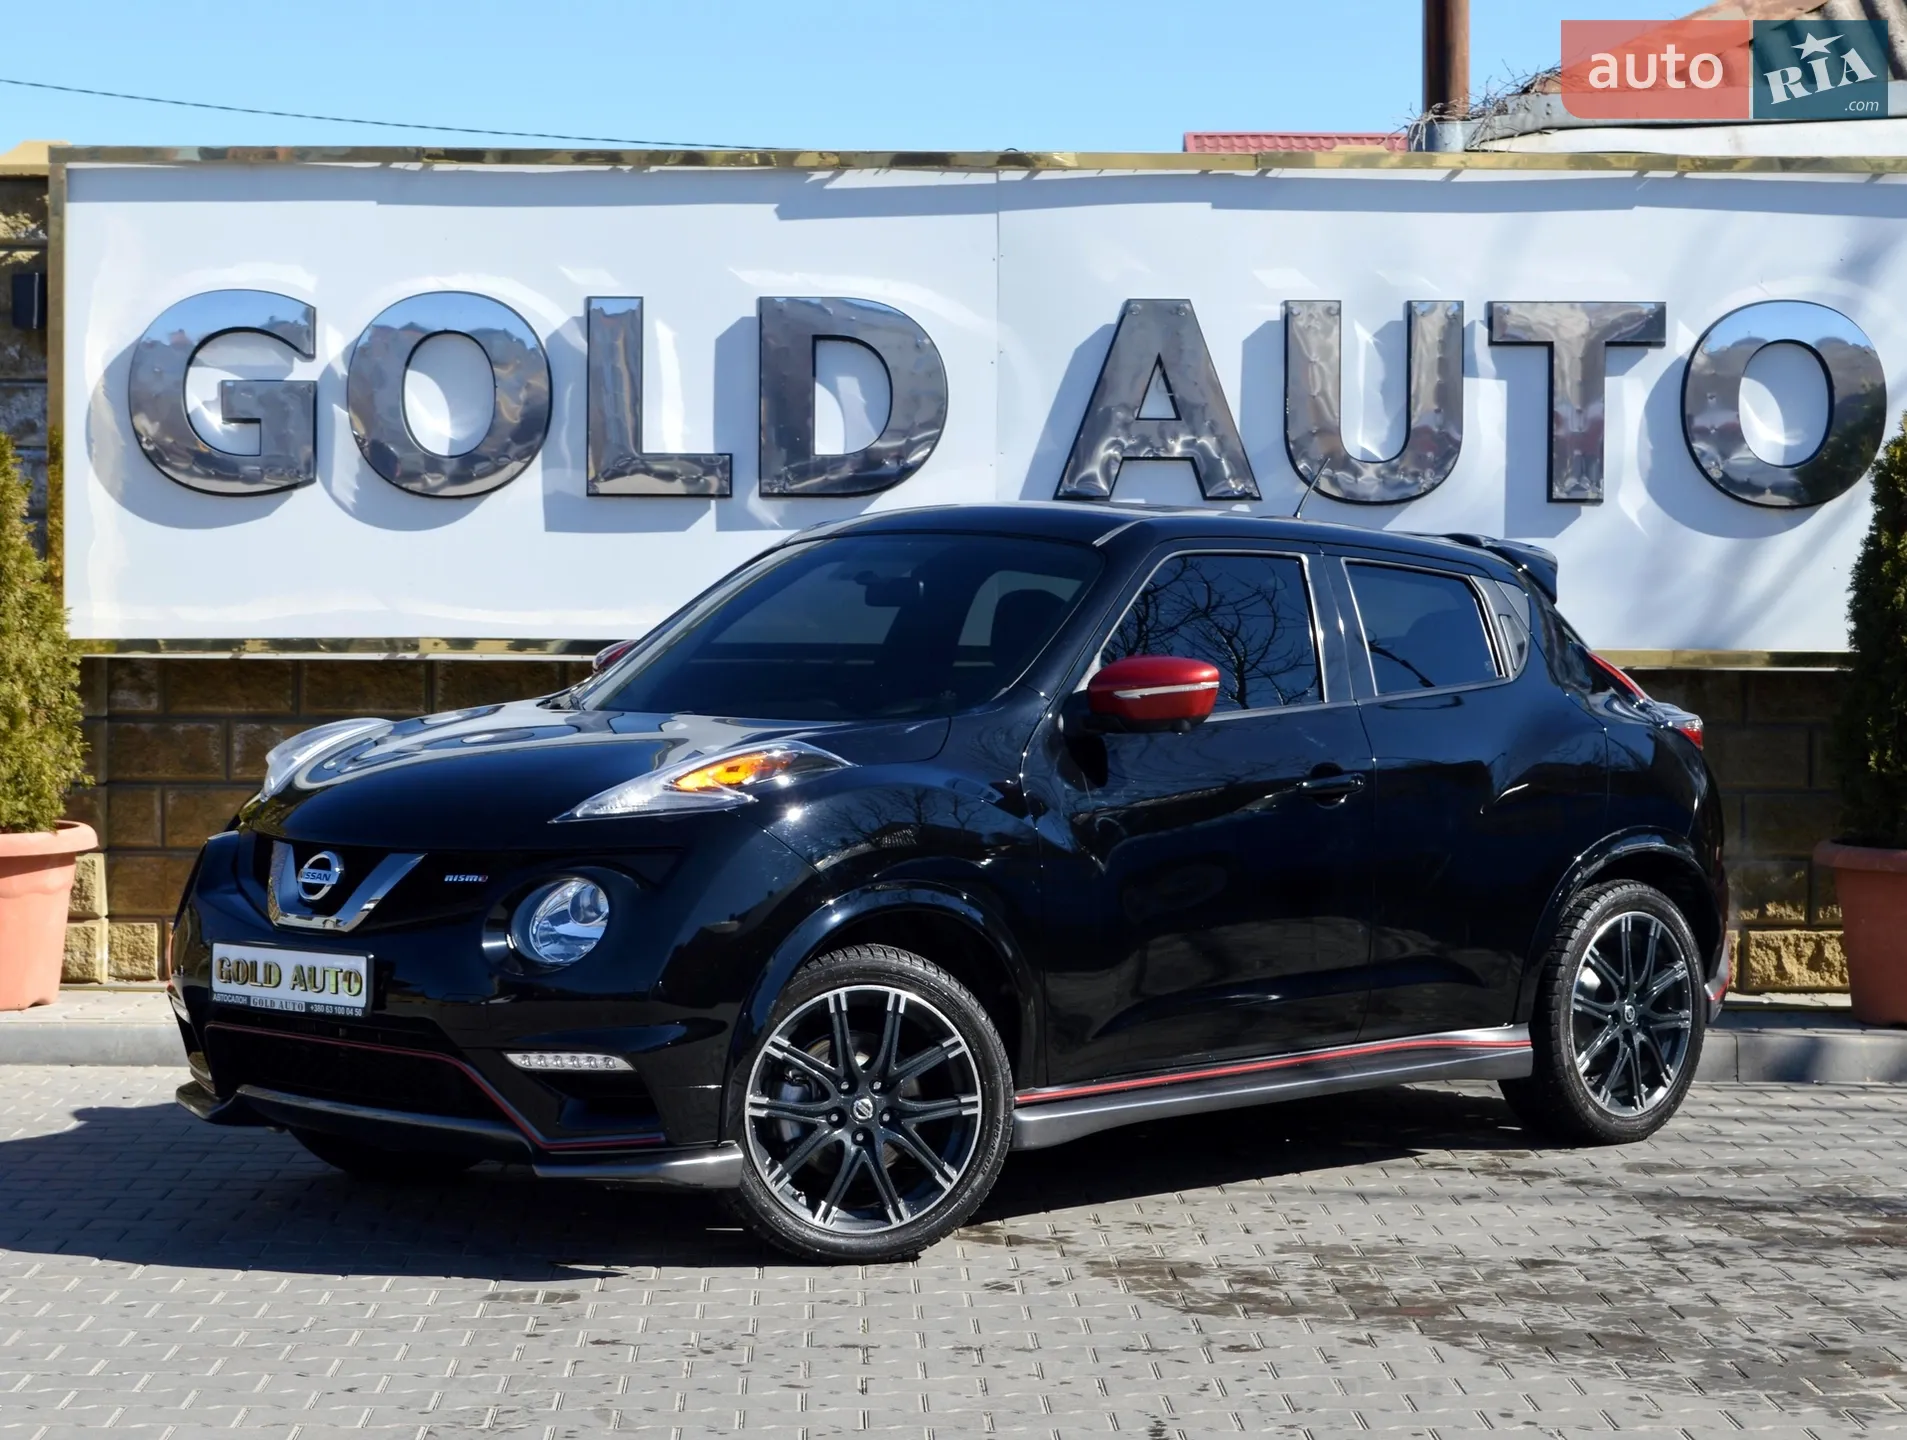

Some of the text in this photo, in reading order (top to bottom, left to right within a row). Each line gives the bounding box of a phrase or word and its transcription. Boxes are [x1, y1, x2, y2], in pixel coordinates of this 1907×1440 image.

[128, 289, 1888, 510] GOLD AUTO
[215, 956, 363, 997] GOLD AUTO
[252, 997, 304, 1011] GOLD AUTO
